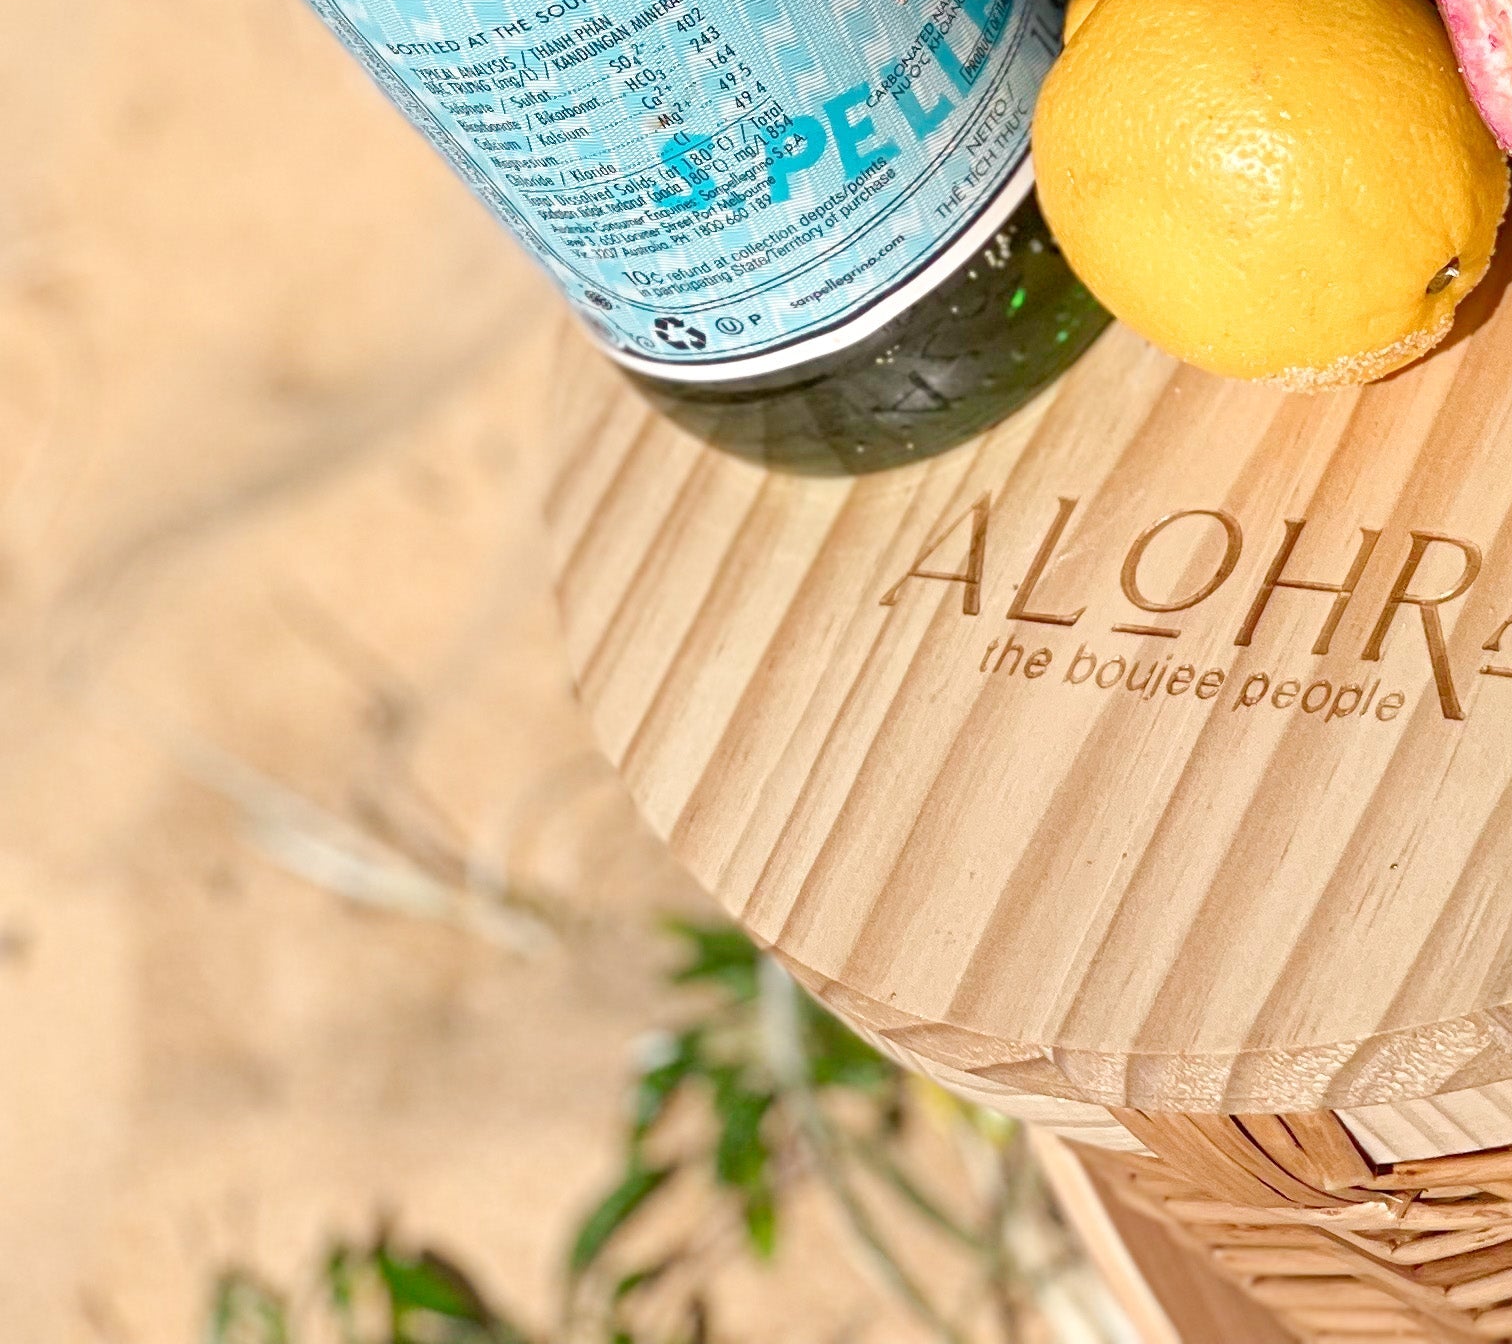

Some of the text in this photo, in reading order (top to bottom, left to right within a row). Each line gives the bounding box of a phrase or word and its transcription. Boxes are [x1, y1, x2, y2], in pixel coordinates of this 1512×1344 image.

[386, 40, 461, 56] BOTTLED
[468, 34, 490, 49] AT
[493, 18, 533, 40] THE
[675, 7, 705, 34] 402
[689, 24, 722, 53] 243
[459, 55, 518, 79] ANALYSIS
[551, 25, 632, 72] KANDUNGAN
[865, 21, 935, 109] CARBONATED
[964, 29, 996, 78] PRODUCT
[538, 124, 591, 148] Kalsium
[705, 43, 737, 71] 164
[769, 114, 794, 141] 854
[966, 95, 1008, 158] NETTO
[553, 185, 614, 206] Dissolved
[614, 174, 656, 196] Solids
[750, 102, 784, 129] Total
[570, 162, 618, 185] Klorida
[700, 156, 775, 202] Sanpellegrino
[716, 176, 776, 214] Melbourne
[650, 270, 733, 298] participating
[730, 223, 825, 278] State/Territory
[836, 169, 897, 221] purchase
[666, 264, 708, 286] refund
[713, 254, 728, 273] at
[730, 223, 798, 263] collection
[799, 155, 889, 228] depots/points
[693, 219, 724, 242] 1800
[724, 210, 748, 229] 660
[750, 194, 772, 220] 189
[790, 233, 906, 309] sanpellegrino.com
[978, 636, 1408, 724] the boujee people
